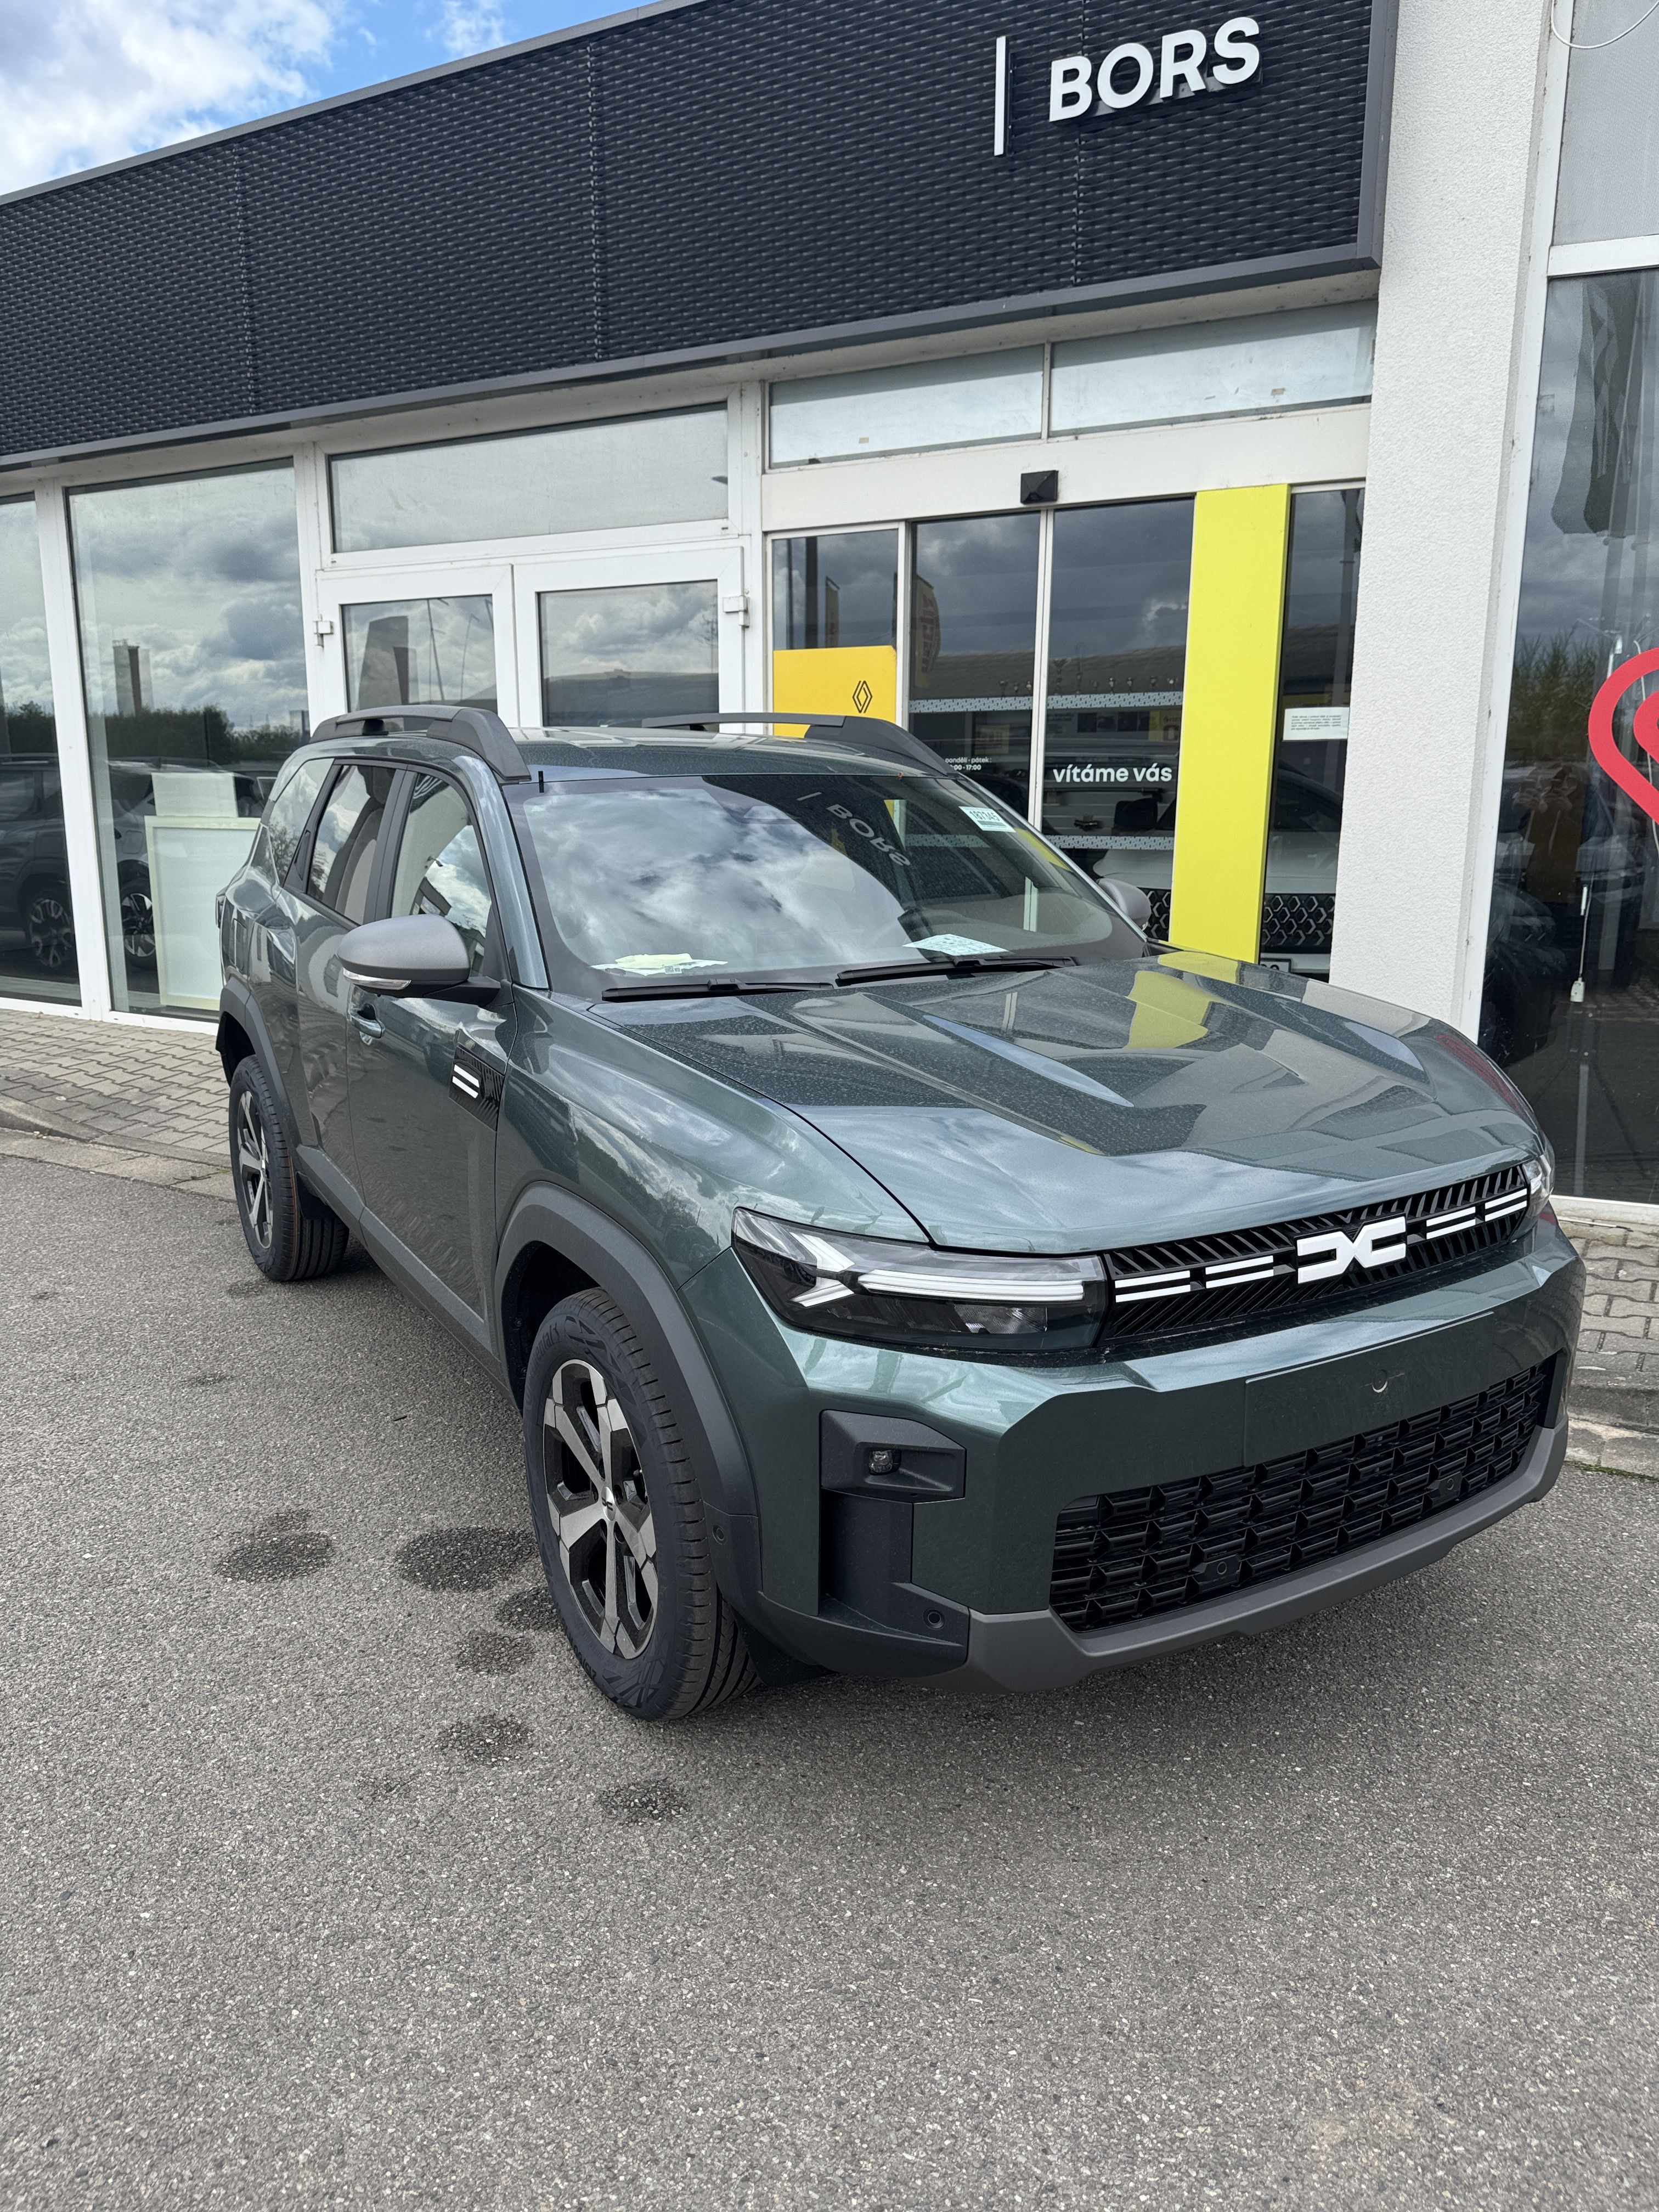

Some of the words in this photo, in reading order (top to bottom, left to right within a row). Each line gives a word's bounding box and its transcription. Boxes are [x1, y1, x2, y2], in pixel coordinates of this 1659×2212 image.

[1049, 16, 1260, 122] BORS
[1053, 764, 1129, 782] vítáme
[1133, 763, 1172, 782] vás
